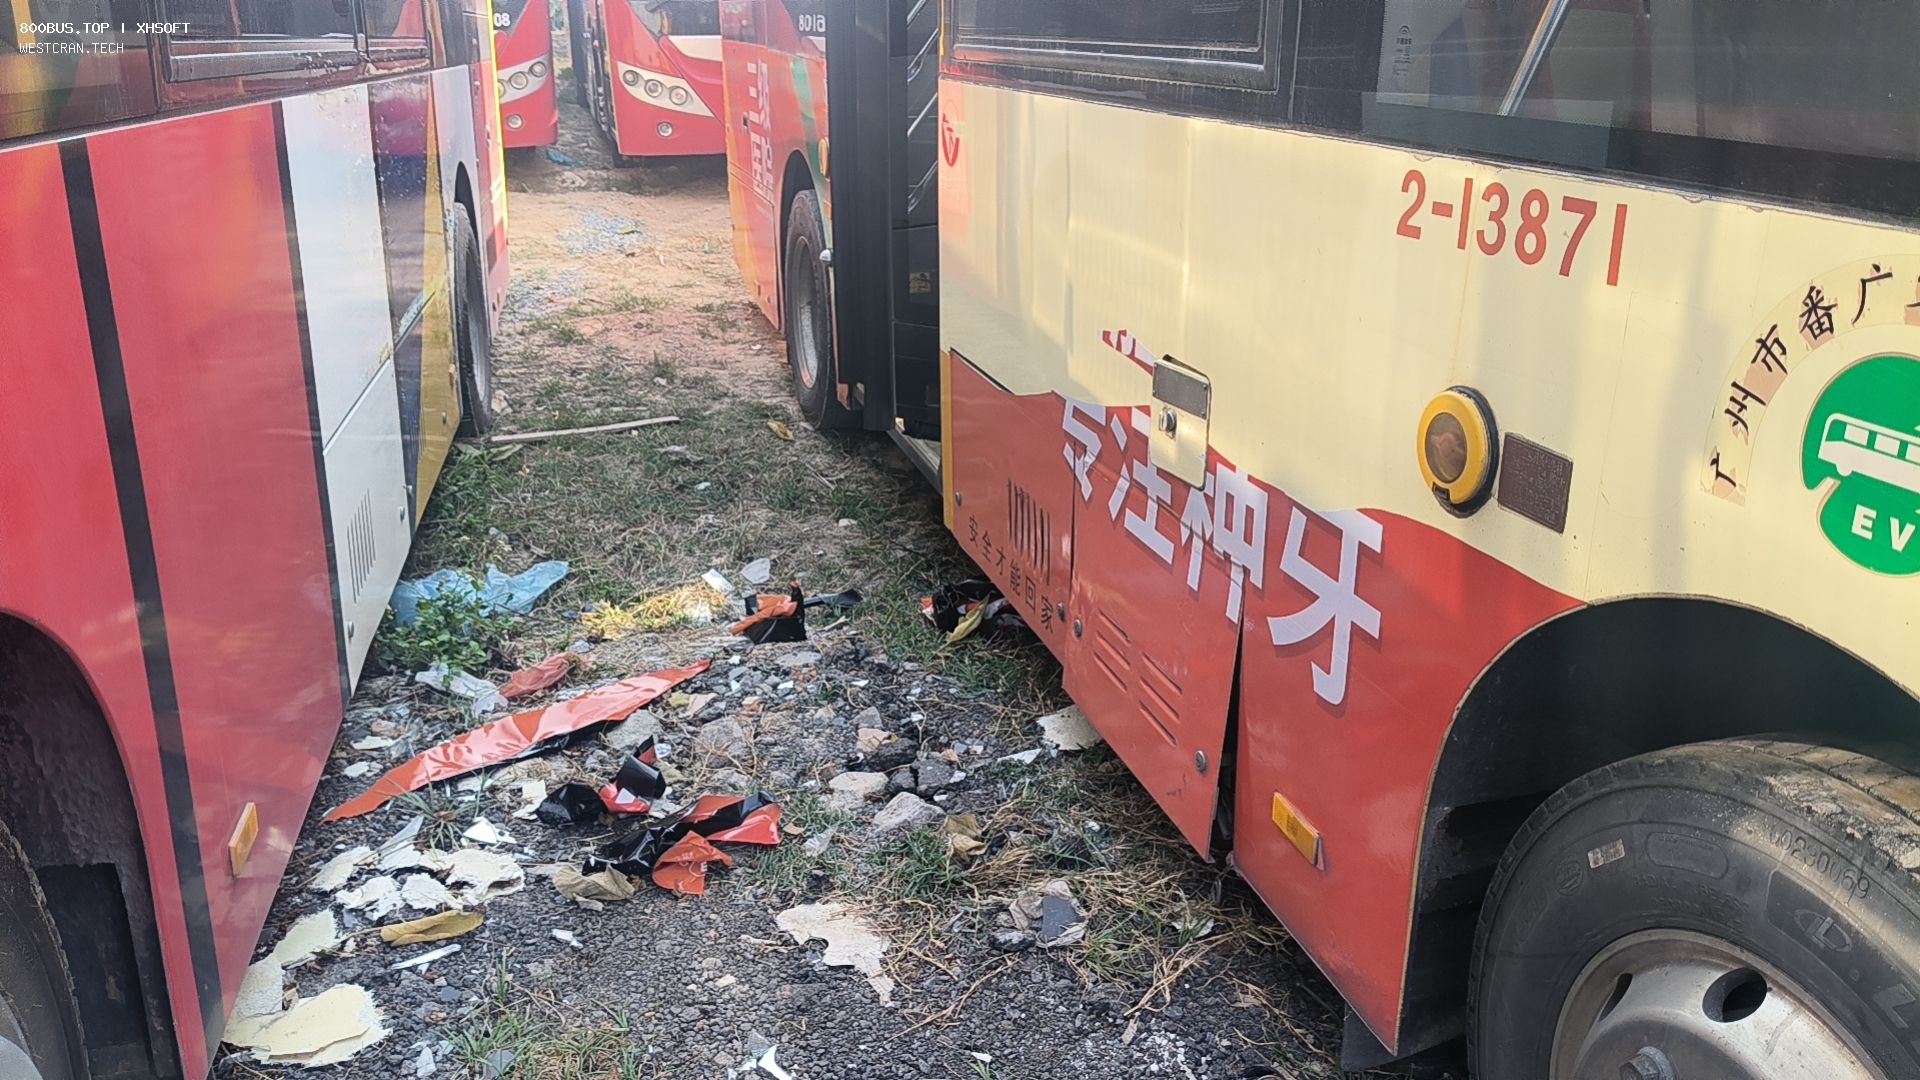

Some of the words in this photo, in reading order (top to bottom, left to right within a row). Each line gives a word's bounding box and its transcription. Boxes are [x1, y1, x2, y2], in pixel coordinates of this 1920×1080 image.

[1396, 169, 1628, 287] 2-13871
[1709, 262, 1920, 489] 广州市番广
[968, 514, 1054, 634] 安全才能回家
